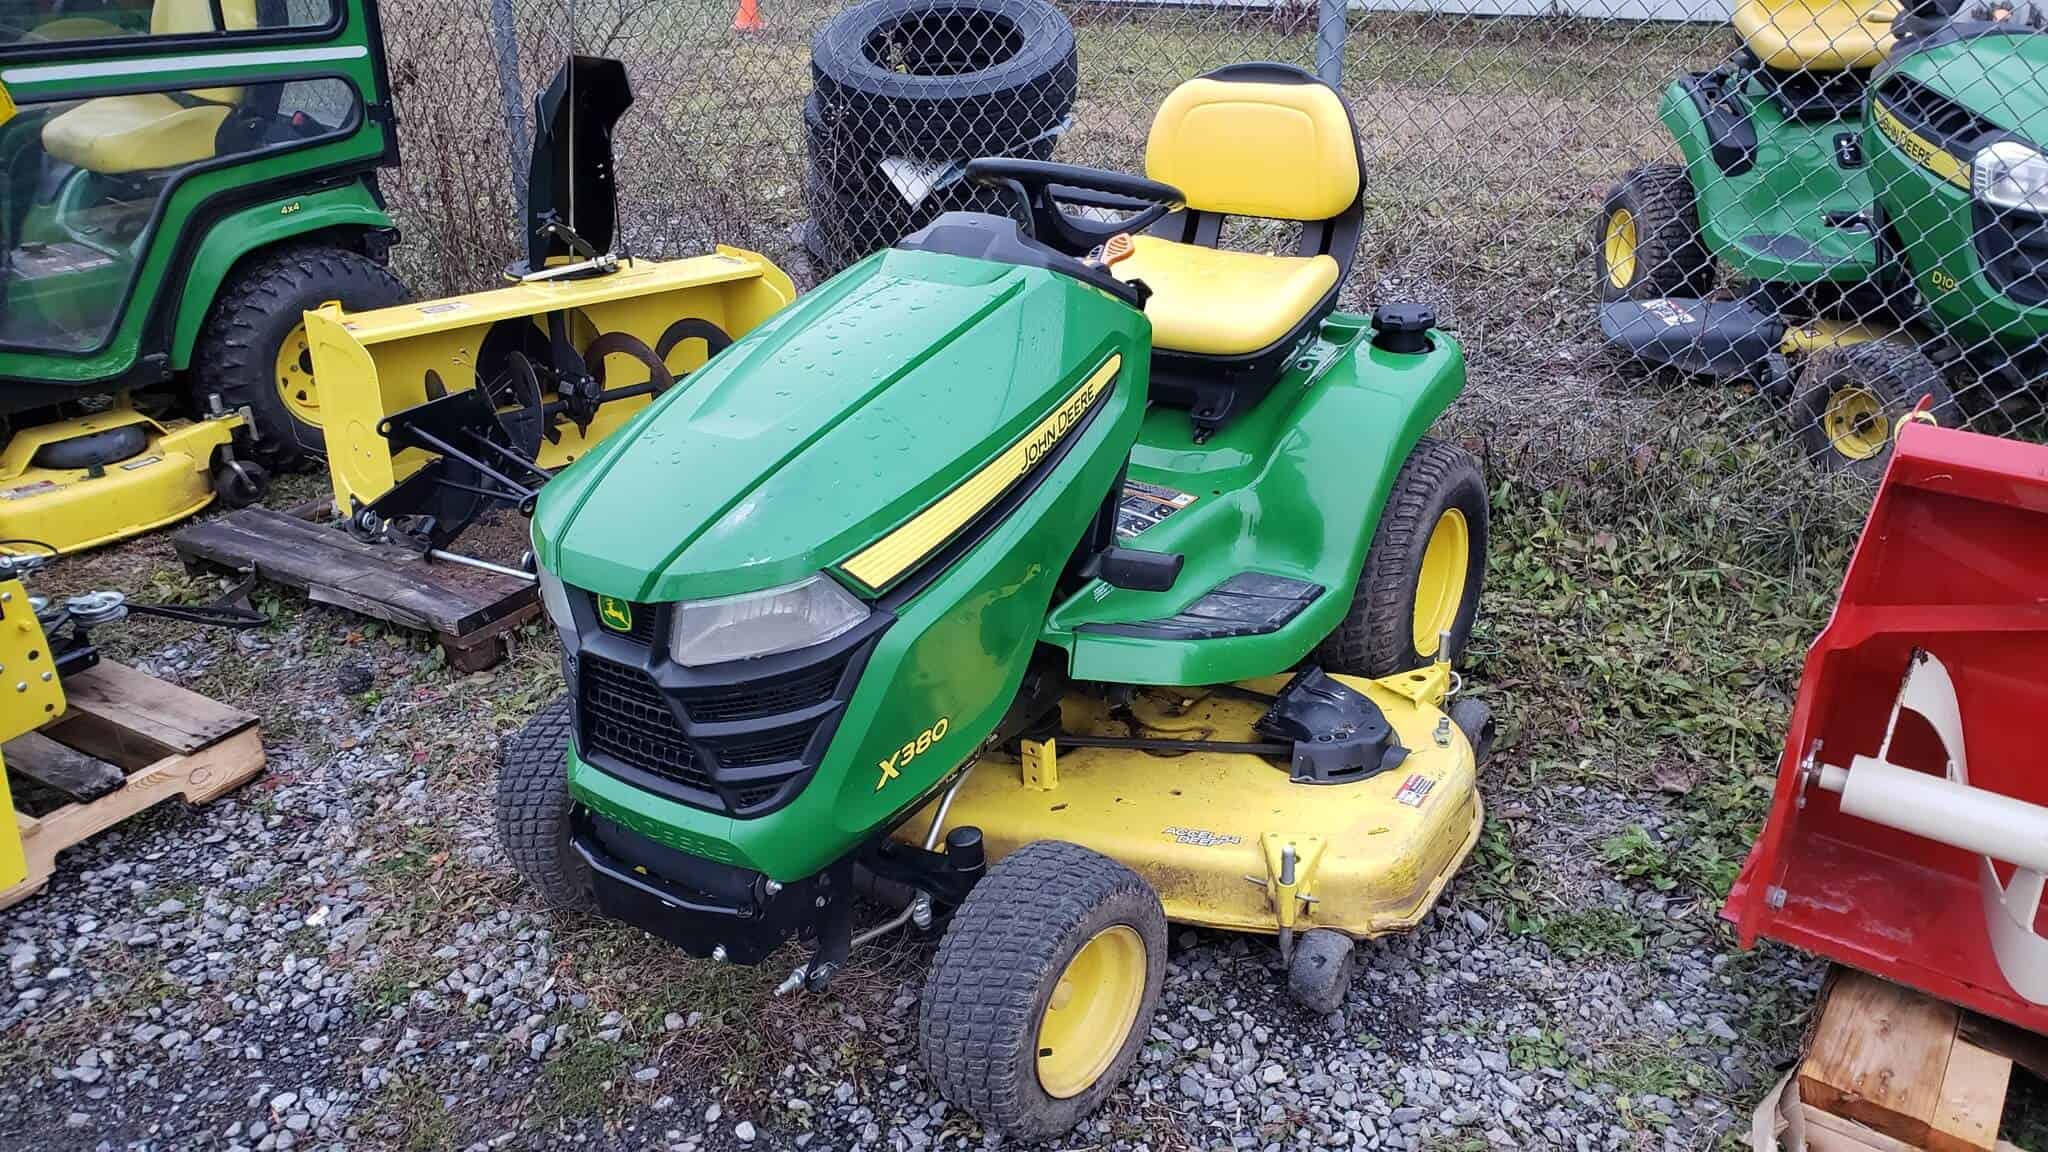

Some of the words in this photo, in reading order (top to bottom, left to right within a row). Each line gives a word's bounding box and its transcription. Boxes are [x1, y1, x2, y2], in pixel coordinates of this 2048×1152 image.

[280, 201, 300, 215] 4x4
[1022, 426, 1056, 471] JOHN
[1058, 384, 1096, 433] DEERE
[874, 717, 949, 791] X380
